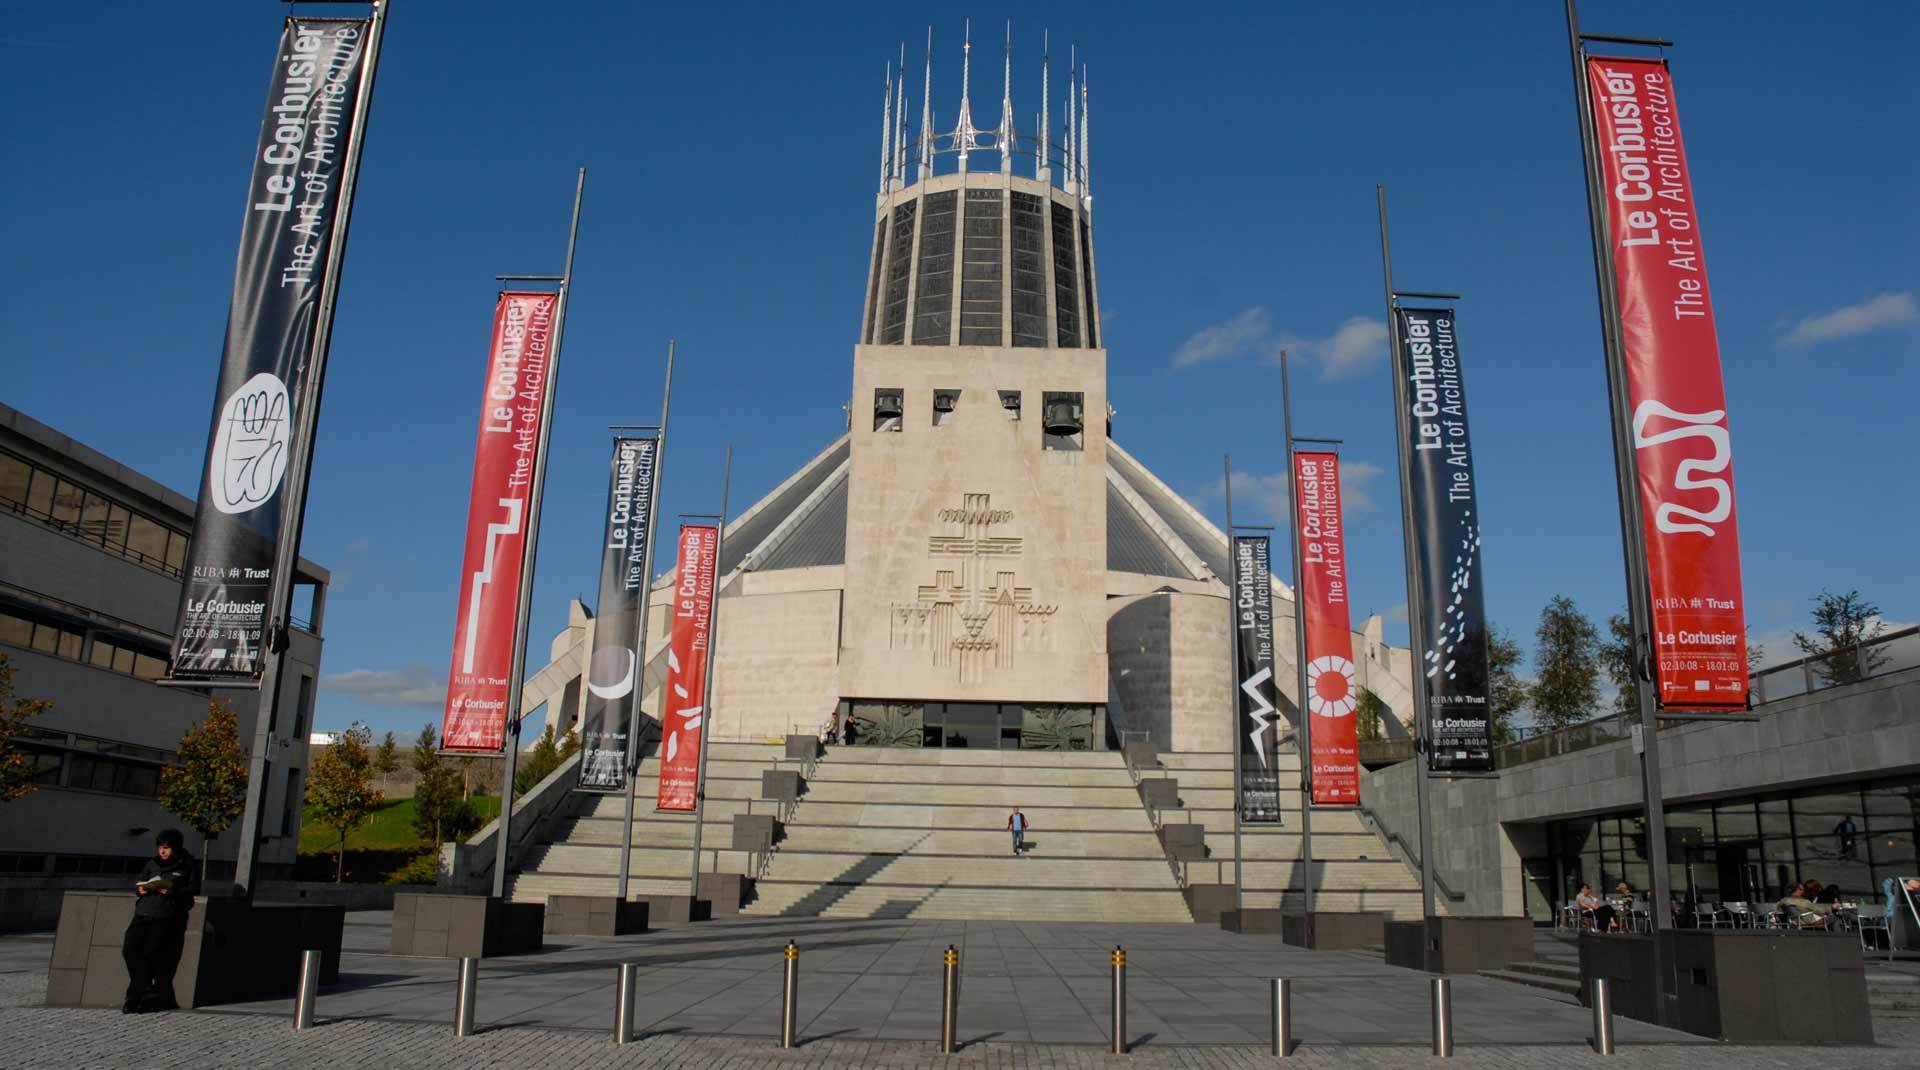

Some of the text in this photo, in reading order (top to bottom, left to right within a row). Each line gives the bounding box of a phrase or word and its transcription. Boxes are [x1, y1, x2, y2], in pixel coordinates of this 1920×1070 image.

[255, 25, 325, 212] Le Corbusier
[281, 27, 359, 287] The Art of Architecture
[1600, 68, 1660, 247] Le Corbusier
[1644, 72, 1705, 320] The Art of Architecture
[486, 299, 527, 433] Le Corbusier
[508, 299, 550, 488] The Art of Architecture
[1405, 316, 1442, 450] Le Corbusier
[1436, 318, 1471, 502] The Art of Architecture
[608, 443, 638, 549] Le Corbusier
[625, 443, 653, 590] The Art of Architecture
[1299, 459, 1324, 563] Le Corbusier
[1321, 460, 1344, 604] The Art of Architecture
[187, 599, 264, 613] Le Corbusier
[193, 566, 269, 578] RIBA Trust
[678, 533, 700, 617] Le Corbusier
[692, 533, 715, 651] The Art of Architecture
[1237, 542, 1255, 628] Le Corbusier
[1255, 543, 1271, 660] The Art of Architecture
[1656, 598, 1734, 609] RIBA Trust
[1659, 630, 1736, 645] Le Corbusier
[452, 698, 504, 709] Le Corbusier
[1432, 718, 1486, 728] Le Corbusier
